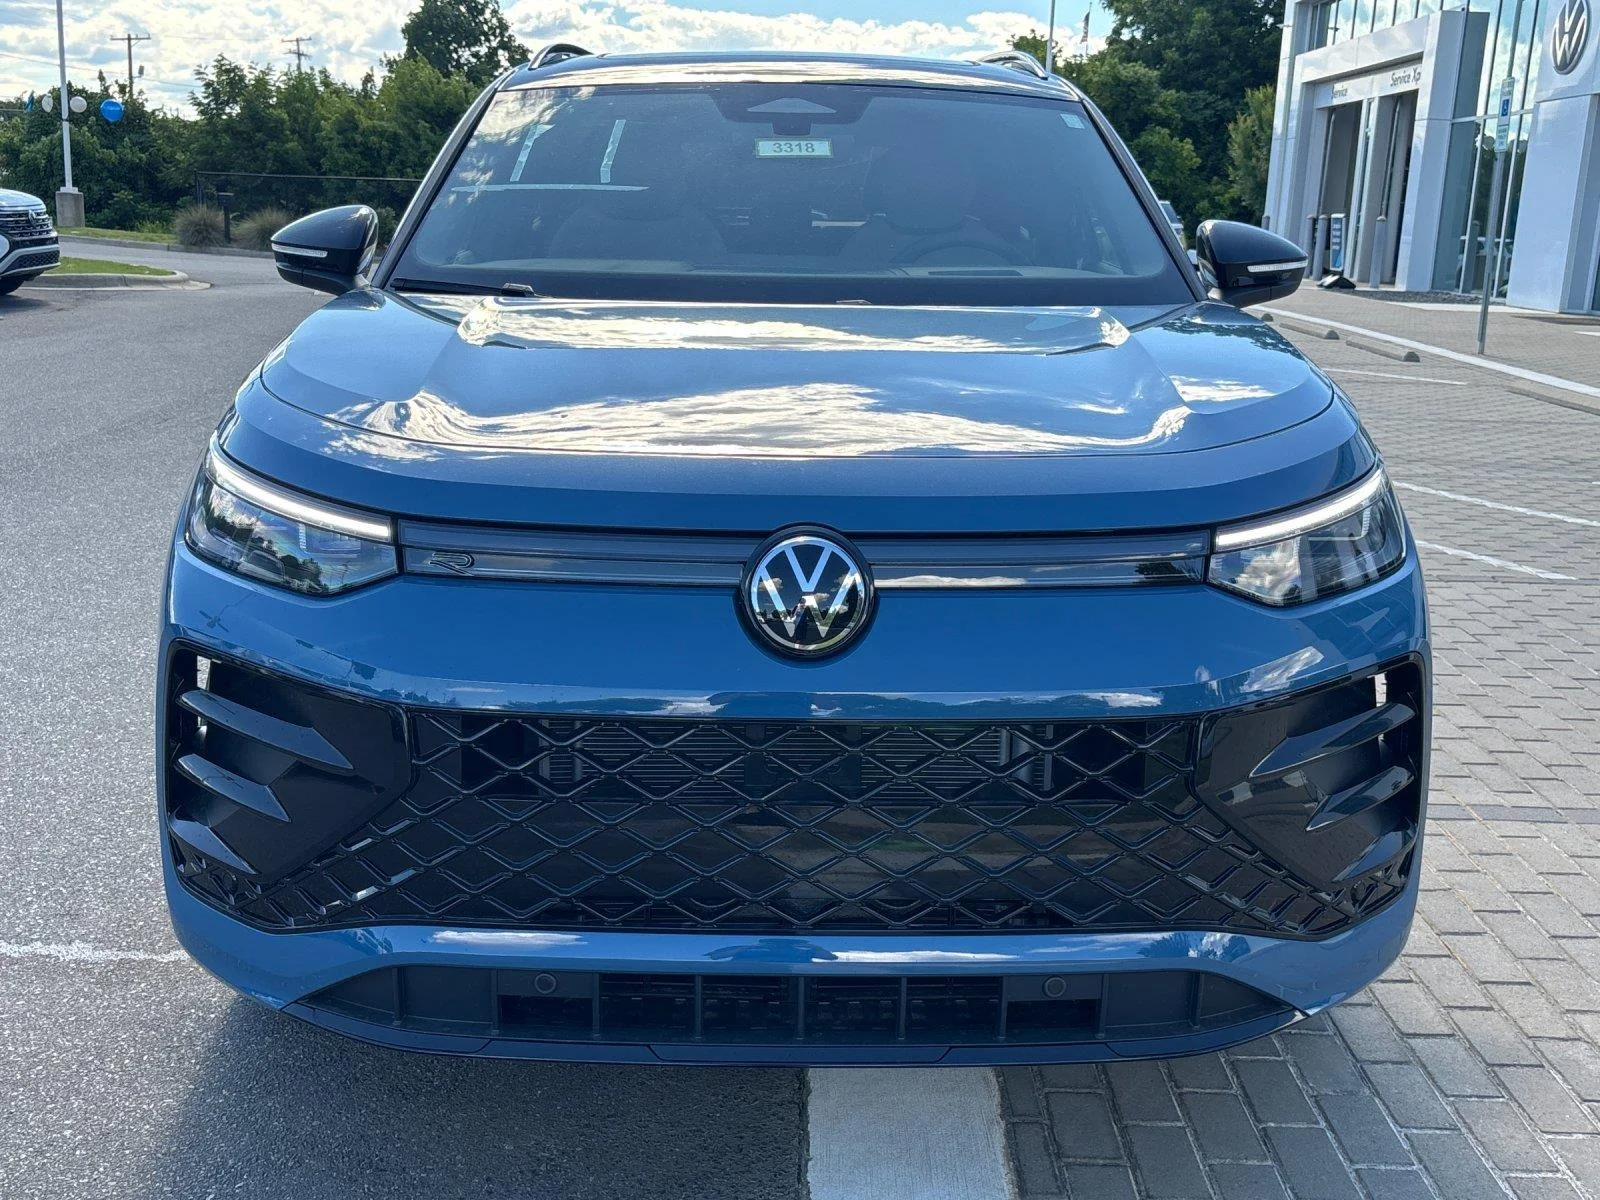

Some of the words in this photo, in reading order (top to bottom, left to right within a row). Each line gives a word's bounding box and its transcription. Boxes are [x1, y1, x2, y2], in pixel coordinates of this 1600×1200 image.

[1391, 70, 1411, 86] Service
[772, 142, 815, 153] 3318
[753, 536, 863, 647] VW
